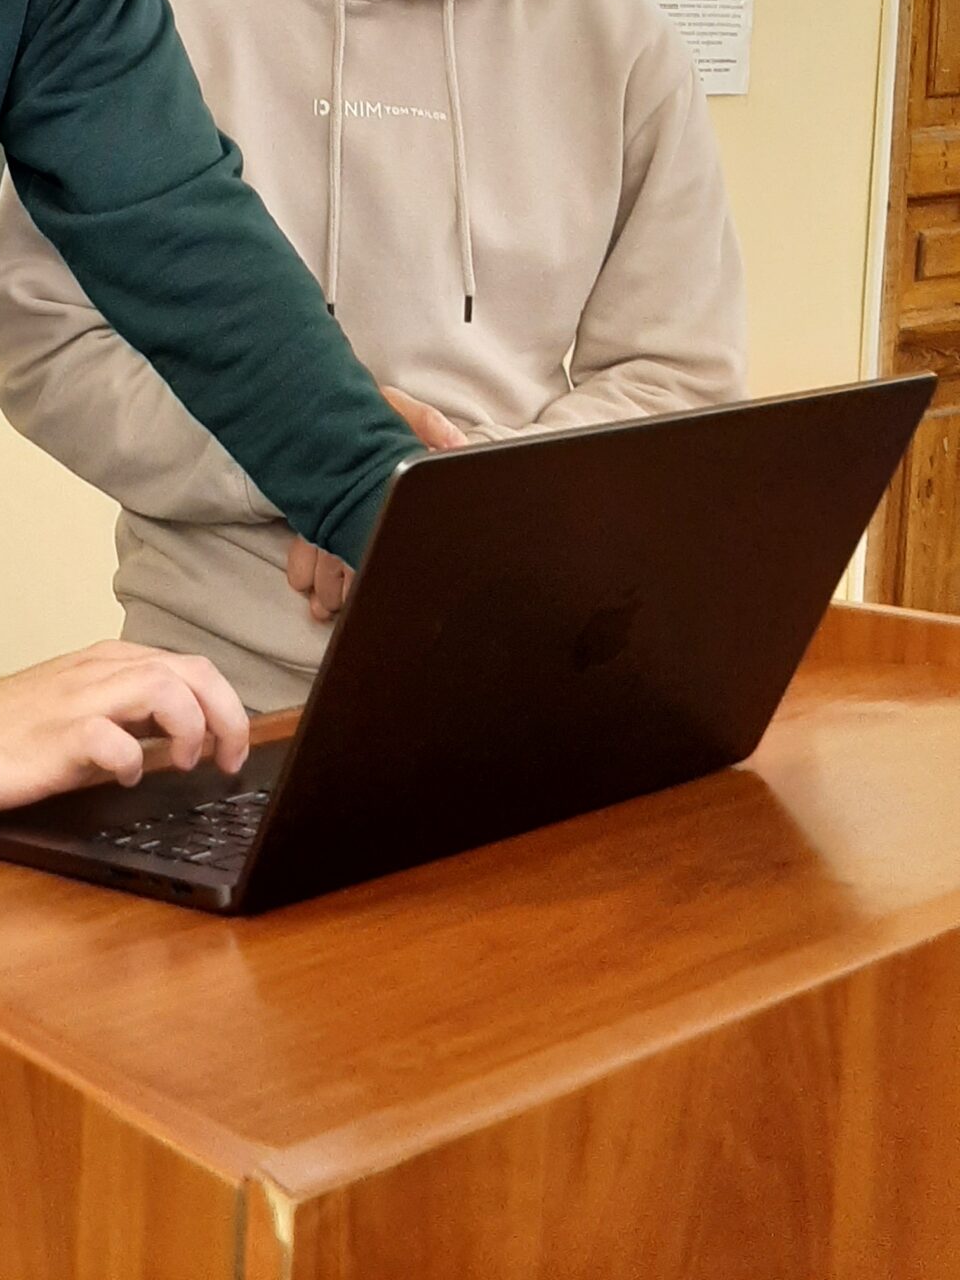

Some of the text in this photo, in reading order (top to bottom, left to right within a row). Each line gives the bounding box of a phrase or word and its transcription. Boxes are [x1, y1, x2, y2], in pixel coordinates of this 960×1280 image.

[313, 99, 447, 120] DNIM TOM TAILOR
